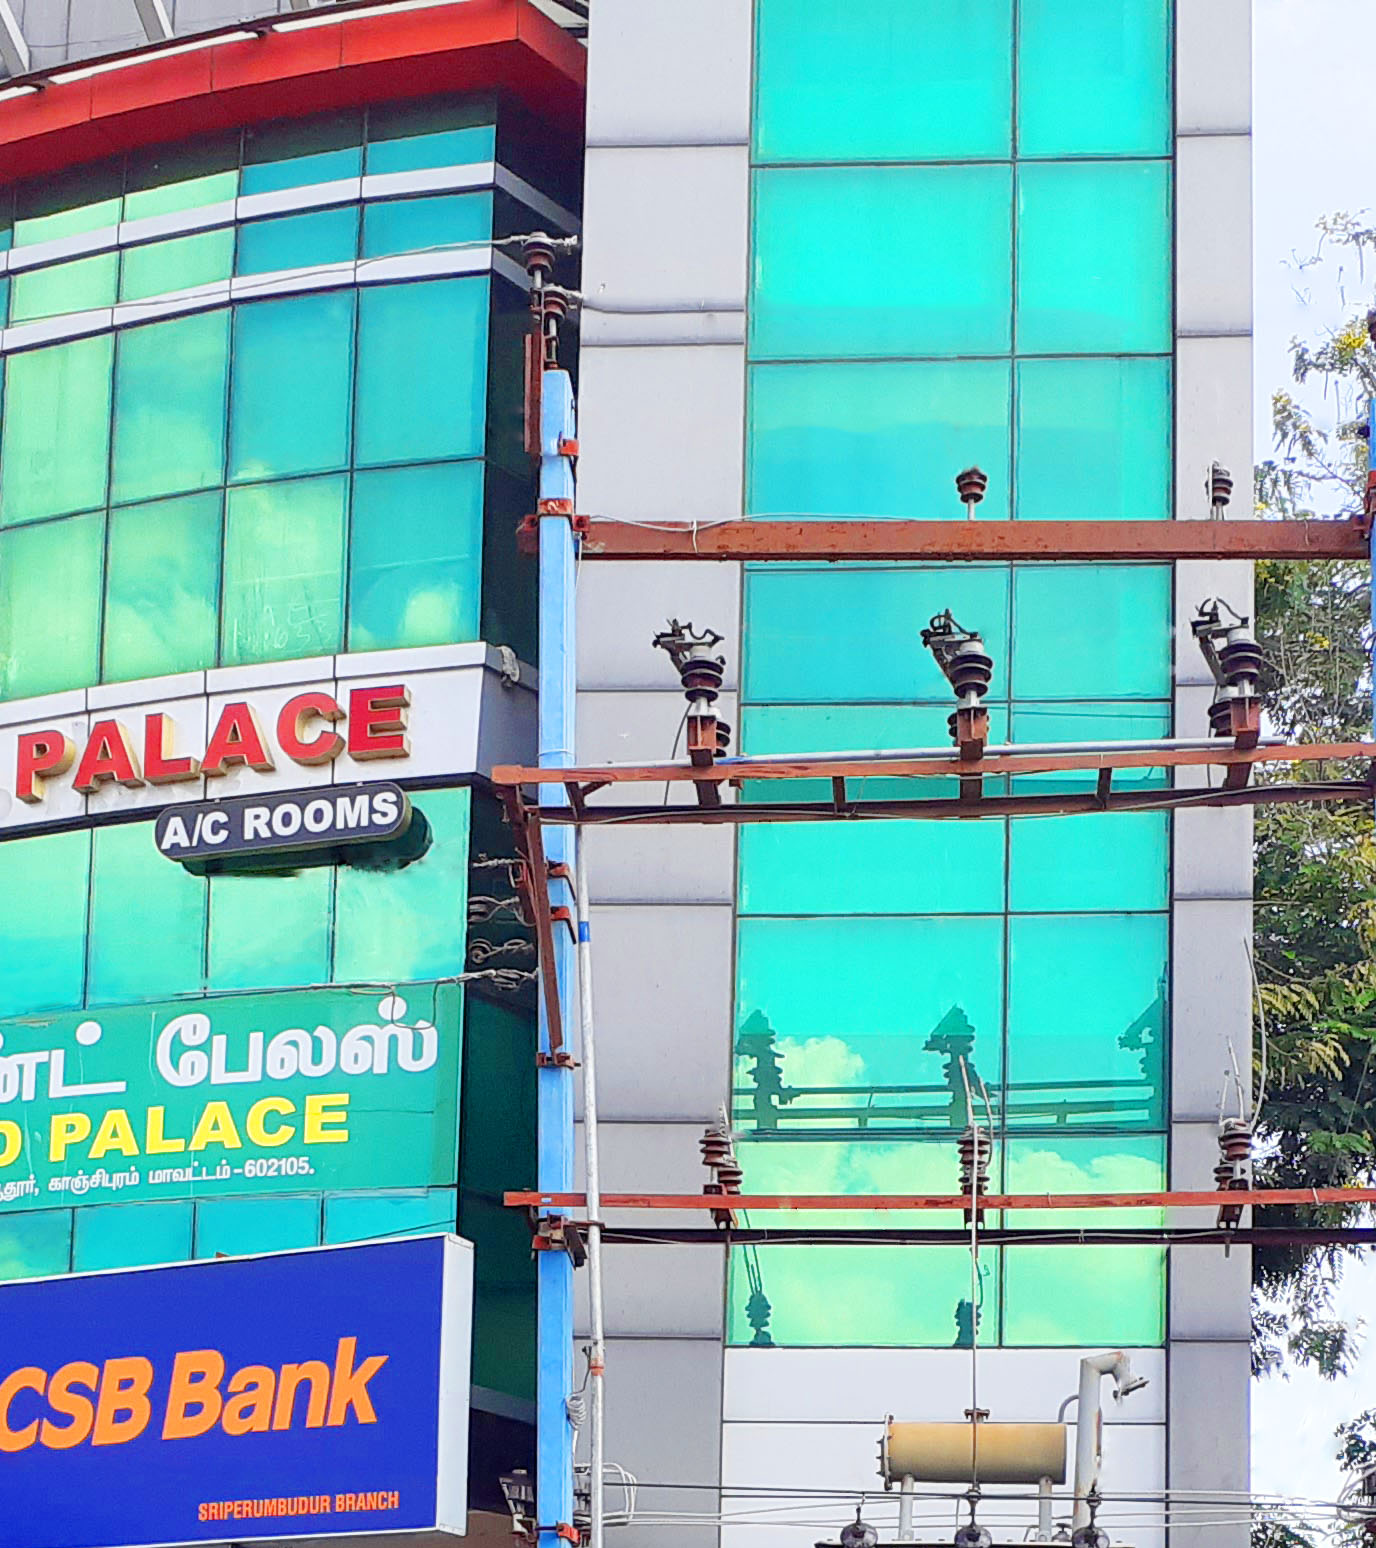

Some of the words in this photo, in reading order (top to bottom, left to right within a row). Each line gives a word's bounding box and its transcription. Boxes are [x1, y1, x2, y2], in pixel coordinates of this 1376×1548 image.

[16, 684, 411, 803] PALACE
[160, 810, 229, 850] A/C
[243, 791, 399, 837] ROOMS
[155, 996, 439, 1088] பேலஸ்
[48, 1093, 350, 1162] PALACE
[161, 1335, 390, 1441] Bank
[197, 1494, 332, 1522] SRIPERUMBUDUR
[334, 1490, 400, 1512] BRANCH
